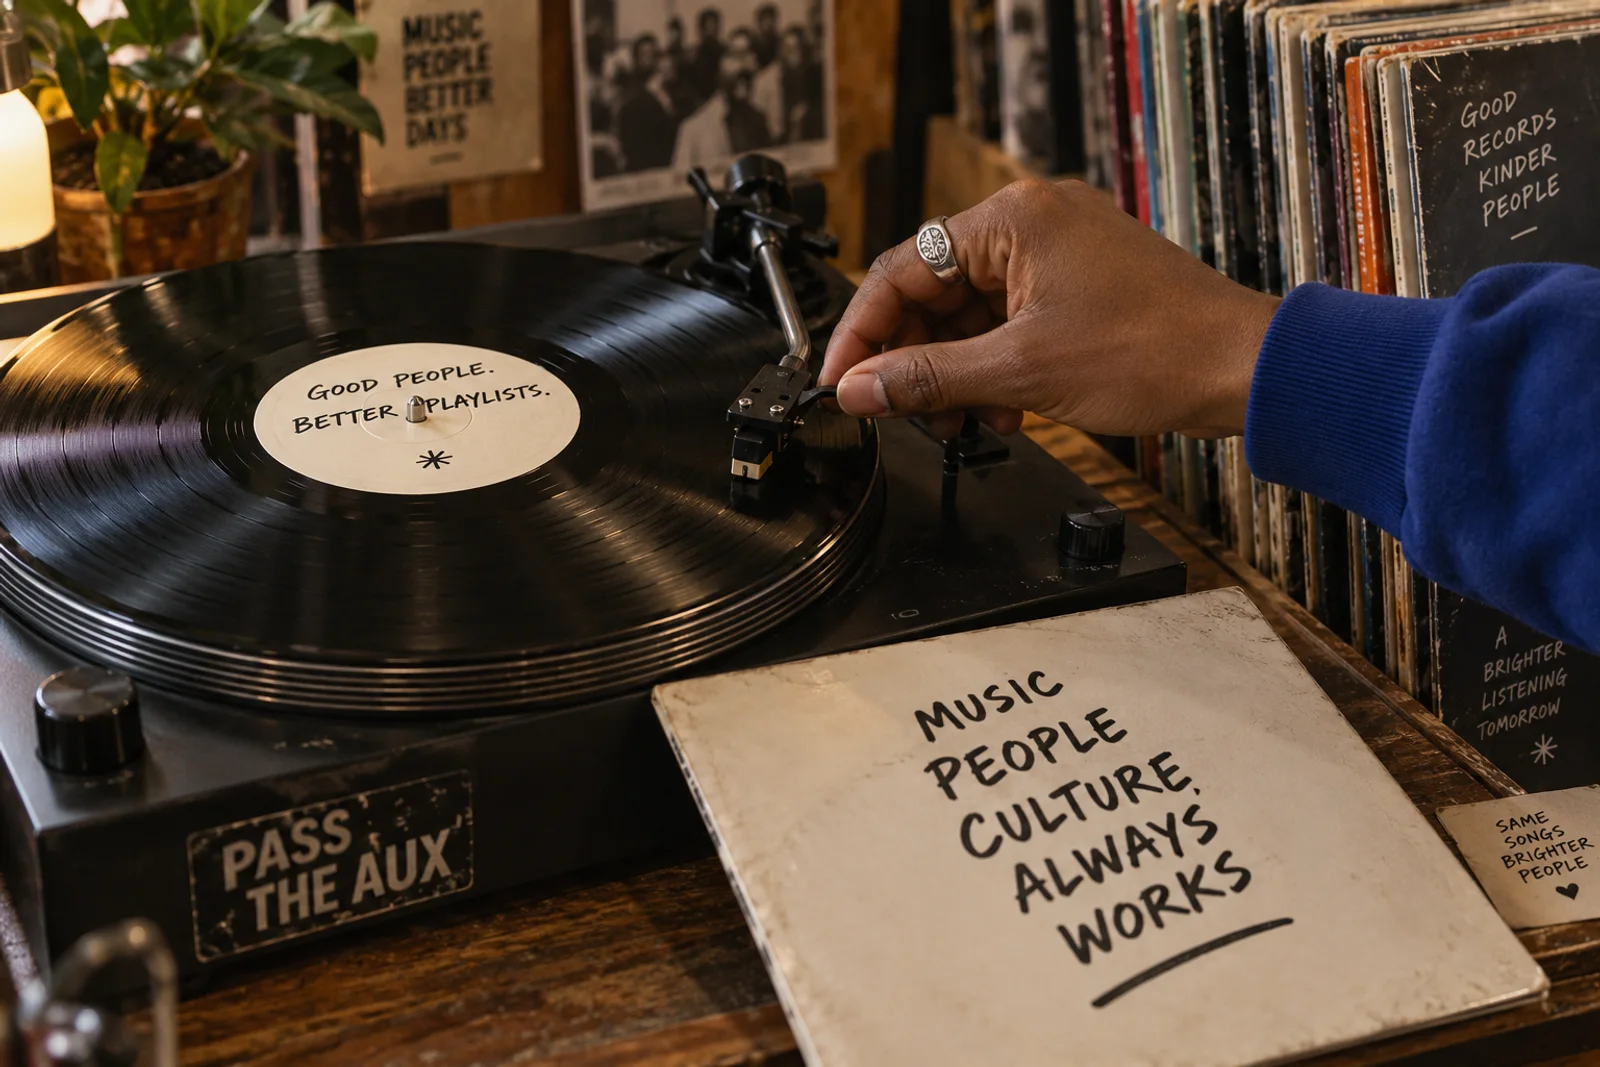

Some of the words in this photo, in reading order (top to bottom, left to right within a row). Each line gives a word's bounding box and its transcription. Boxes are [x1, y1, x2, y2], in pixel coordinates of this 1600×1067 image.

[403, 11, 483, 46] MUSIC
[403, 42, 491, 81] PEOPLE
[405, 78, 493, 114] BETTER
[1461, 91, 1517, 128] GOOD
[406, 113, 468, 148] DAYS
[1463, 108, 1557, 165] RECORDS
[1479, 143, 1557, 193] KINDER
[1482, 173, 1560, 227] PEOPLE
[307, 378, 379, 401] GOOD
[393, 362, 495, 388] PEOPLE.
[292, 404, 398, 435] BETTER
[423, 384, 551, 414] PLAYLISTS.
[1495, 625, 1507, 650] A
[1483, 640, 1566, 683] BRIGHTER
[914, 670, 1064, 743] MUSIC
[1481, 667, 1568, 711] LISTENING
[1477, 697, 1561, 740] TOMORROW
[923, 707, 1128, 801] PEOPLE
[960, 751, 1201, 859] CULTURE.
[1496, 811, 1549, 833] SAME
[222, 809, 352, 892] PASS
[1501, 837, 1595, 869] BRIGHTER
[1504, 825, 1565, 849] SONGS
[246, 863, 339, 932] THE
[352, 828, 451, 904] AUX
[1015, 804, 1218, 915] ALWAYS
[1518, 856, 1589, 884] PEOPLE
[1056, 850, 1252, 965] WORKS
